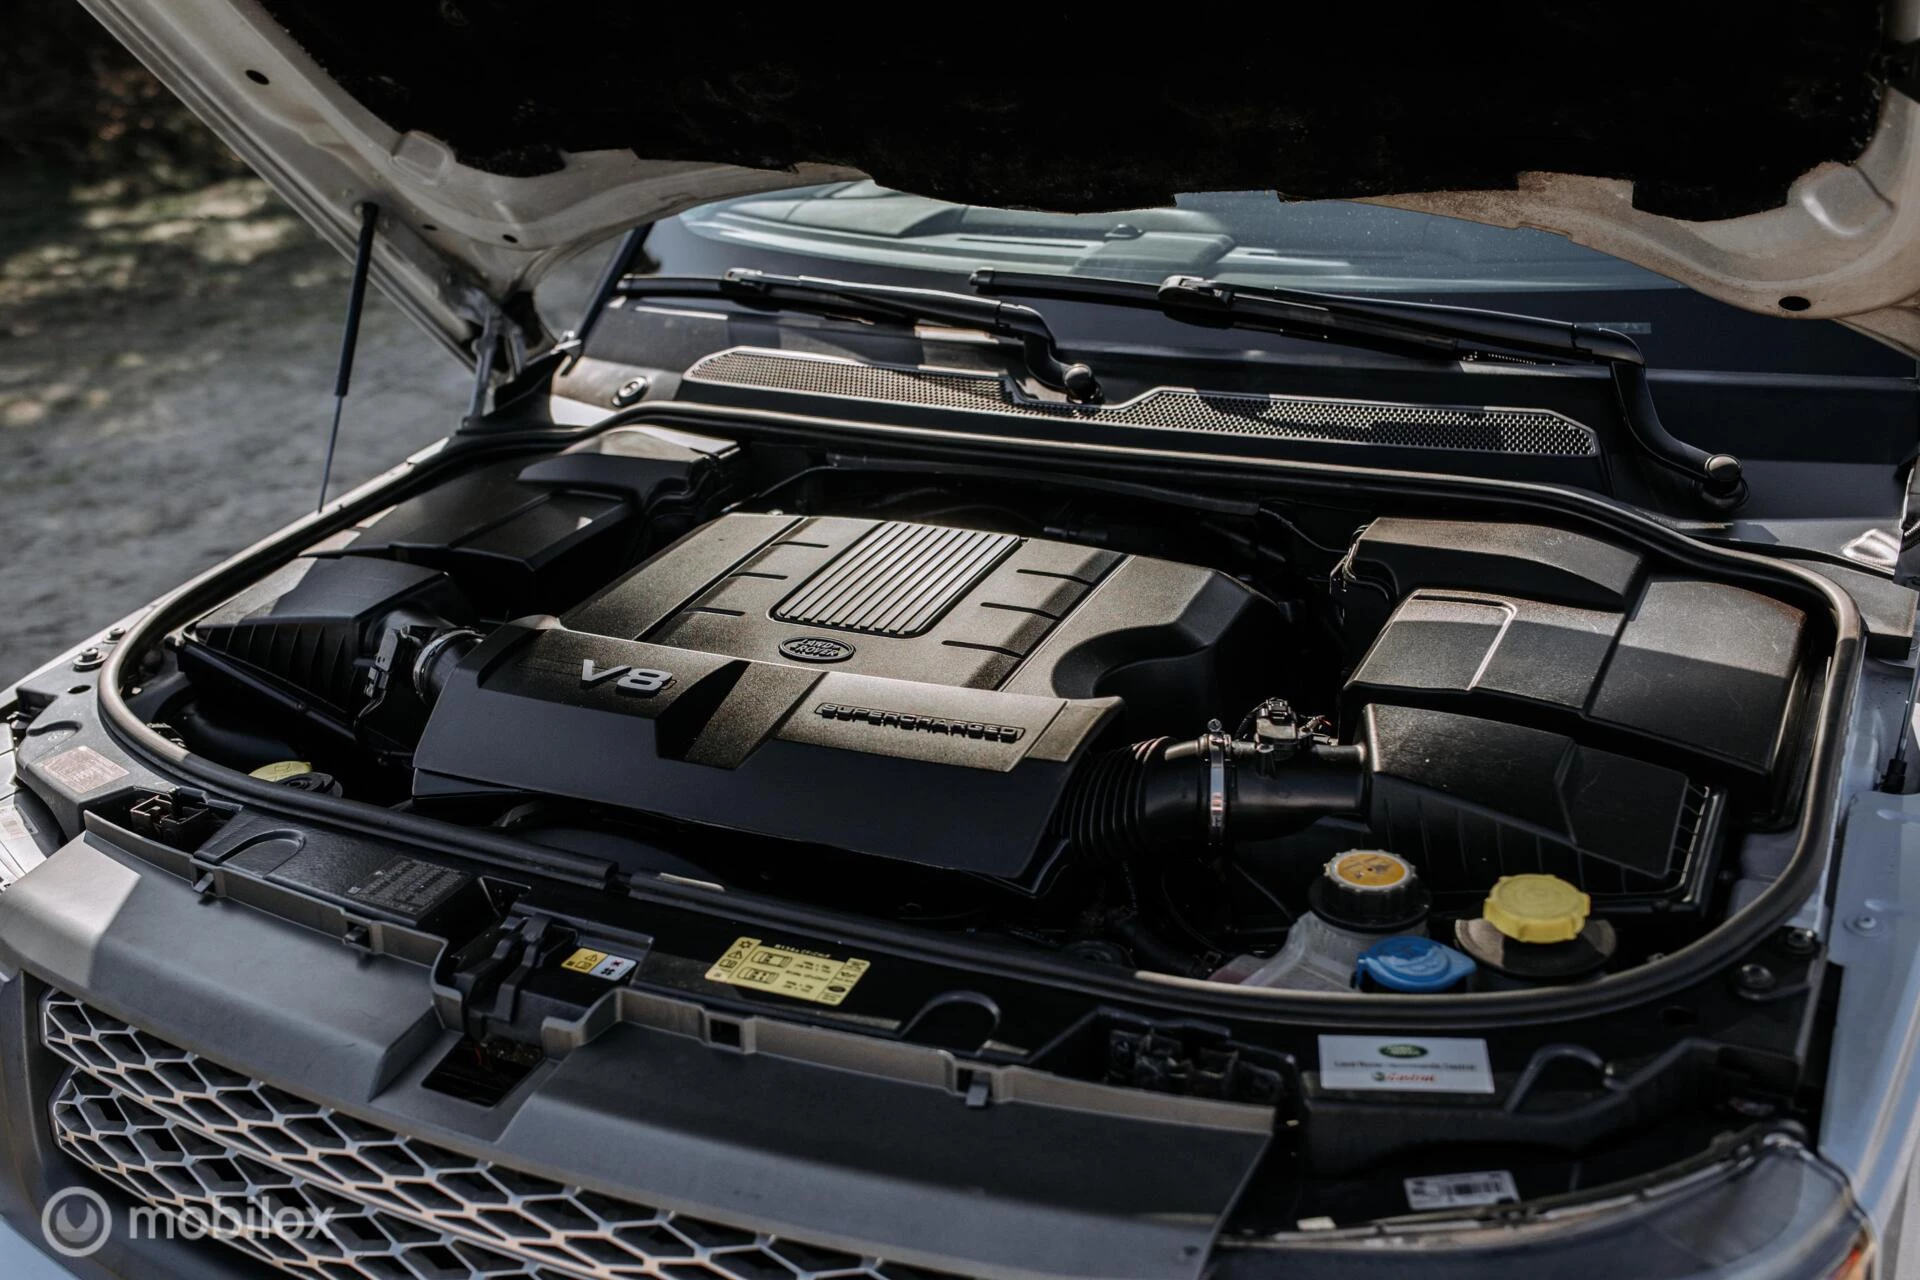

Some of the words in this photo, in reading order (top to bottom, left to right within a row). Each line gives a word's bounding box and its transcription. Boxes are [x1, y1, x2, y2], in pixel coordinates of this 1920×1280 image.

[796, 645, 839, 656] ROVER
[801, 639, 834, 649] LAND
[582, 659, 673, 693] V8
[822, 703, 1018, 742] SUPERCHARGED
